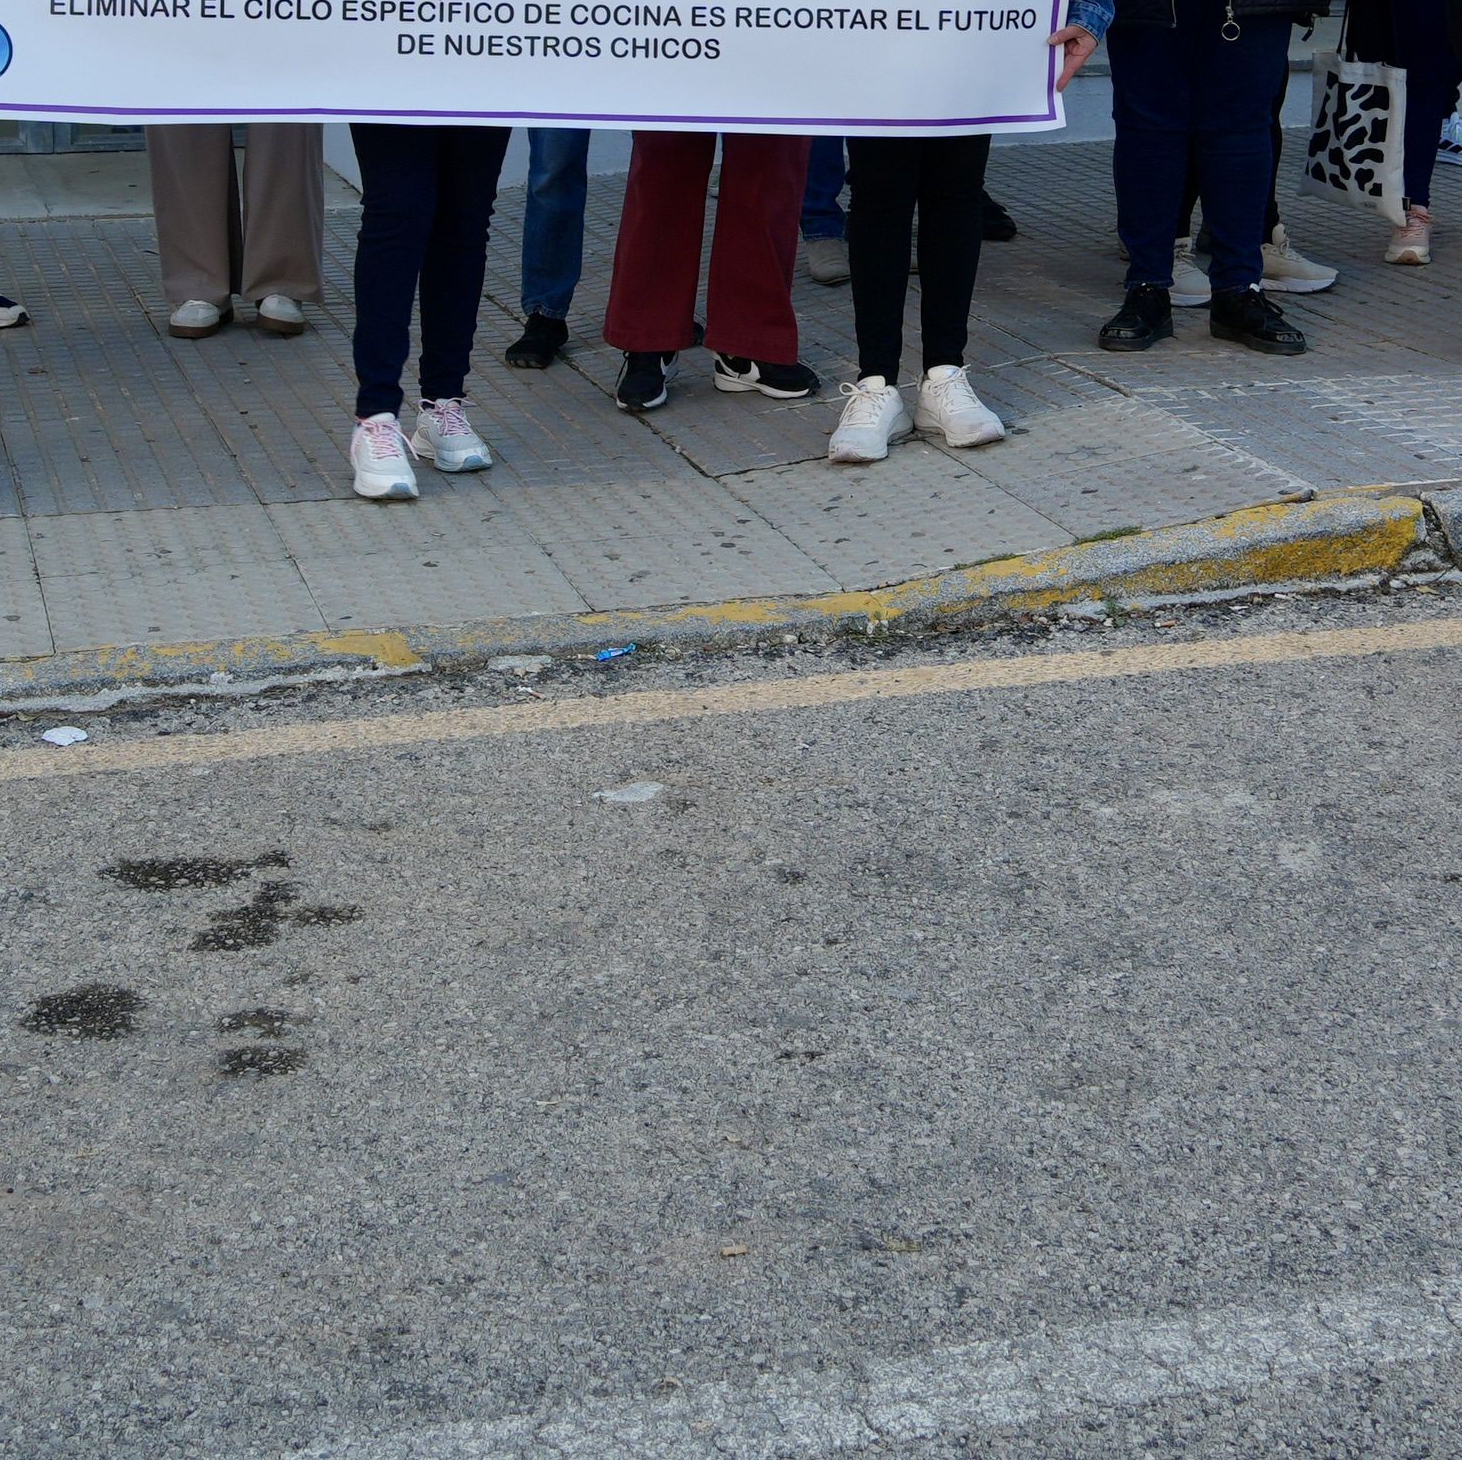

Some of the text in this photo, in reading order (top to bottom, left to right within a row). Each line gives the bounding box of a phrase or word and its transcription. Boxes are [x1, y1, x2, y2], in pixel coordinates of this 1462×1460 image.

[524, 3, 561, 25] DE
[570, 4, 682, 28] COCINA
[690, 6, 726, 28] ES
[736, 8, 888, 30] RECORTAR
[897, 9, 929, 31] EL
[939, 8, 1037, 31] FUTURO
[397, 33, 721, 60] DE NUESTROS CHICOS
